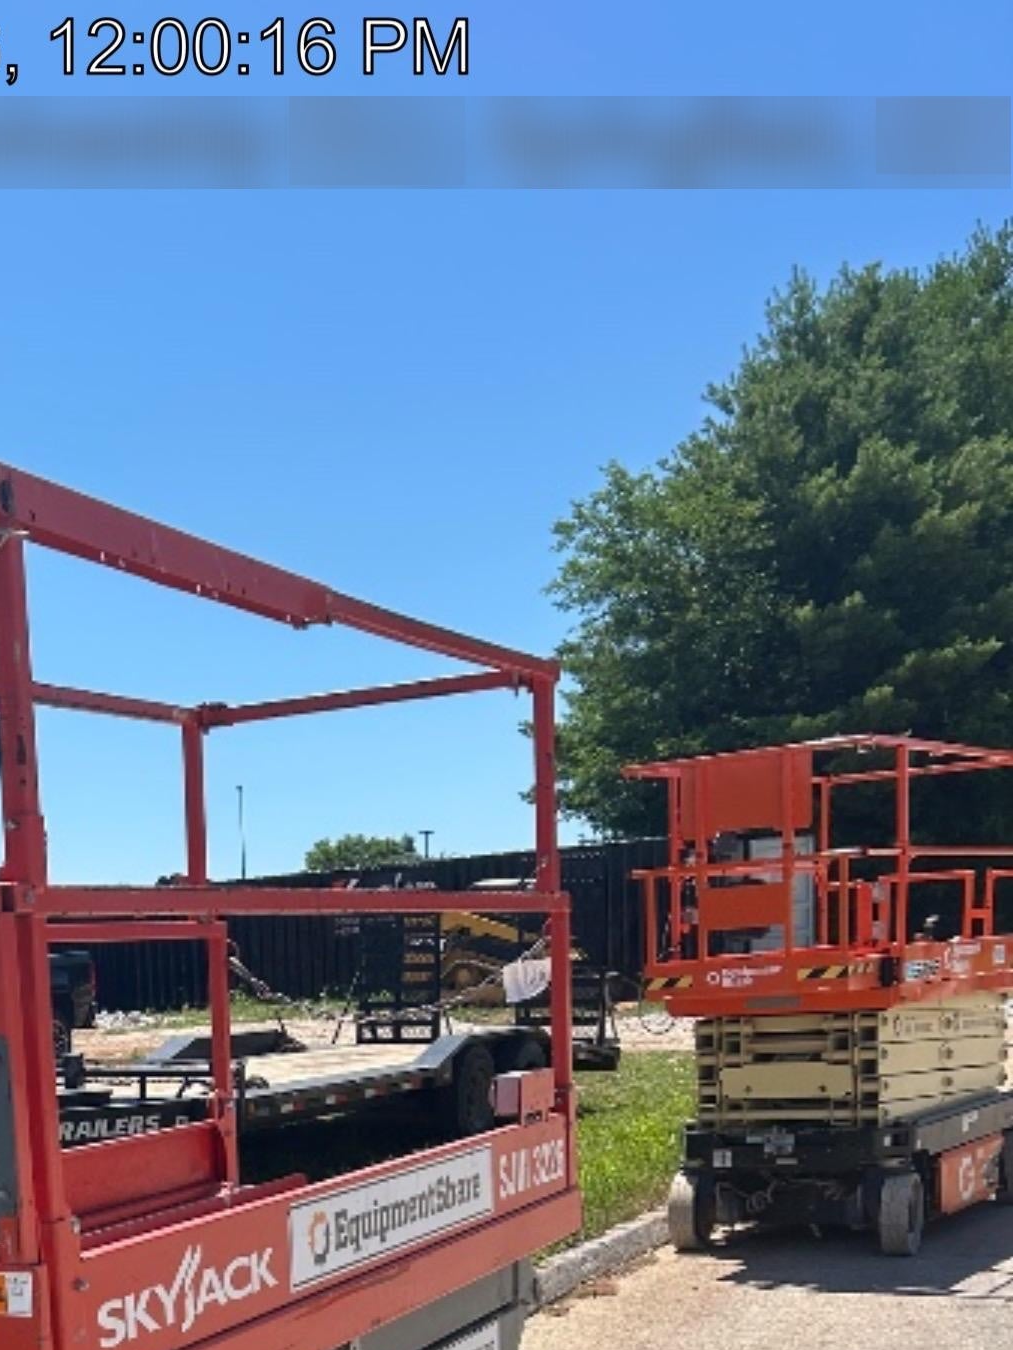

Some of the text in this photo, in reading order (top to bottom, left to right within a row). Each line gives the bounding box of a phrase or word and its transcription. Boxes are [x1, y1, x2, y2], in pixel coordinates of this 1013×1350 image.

[59, 1114, 162, 1141] RAILERS
[334, 1172, 480, 1252] EquipmentShare
[97, 1244, 278, 1349] SKYJACK
